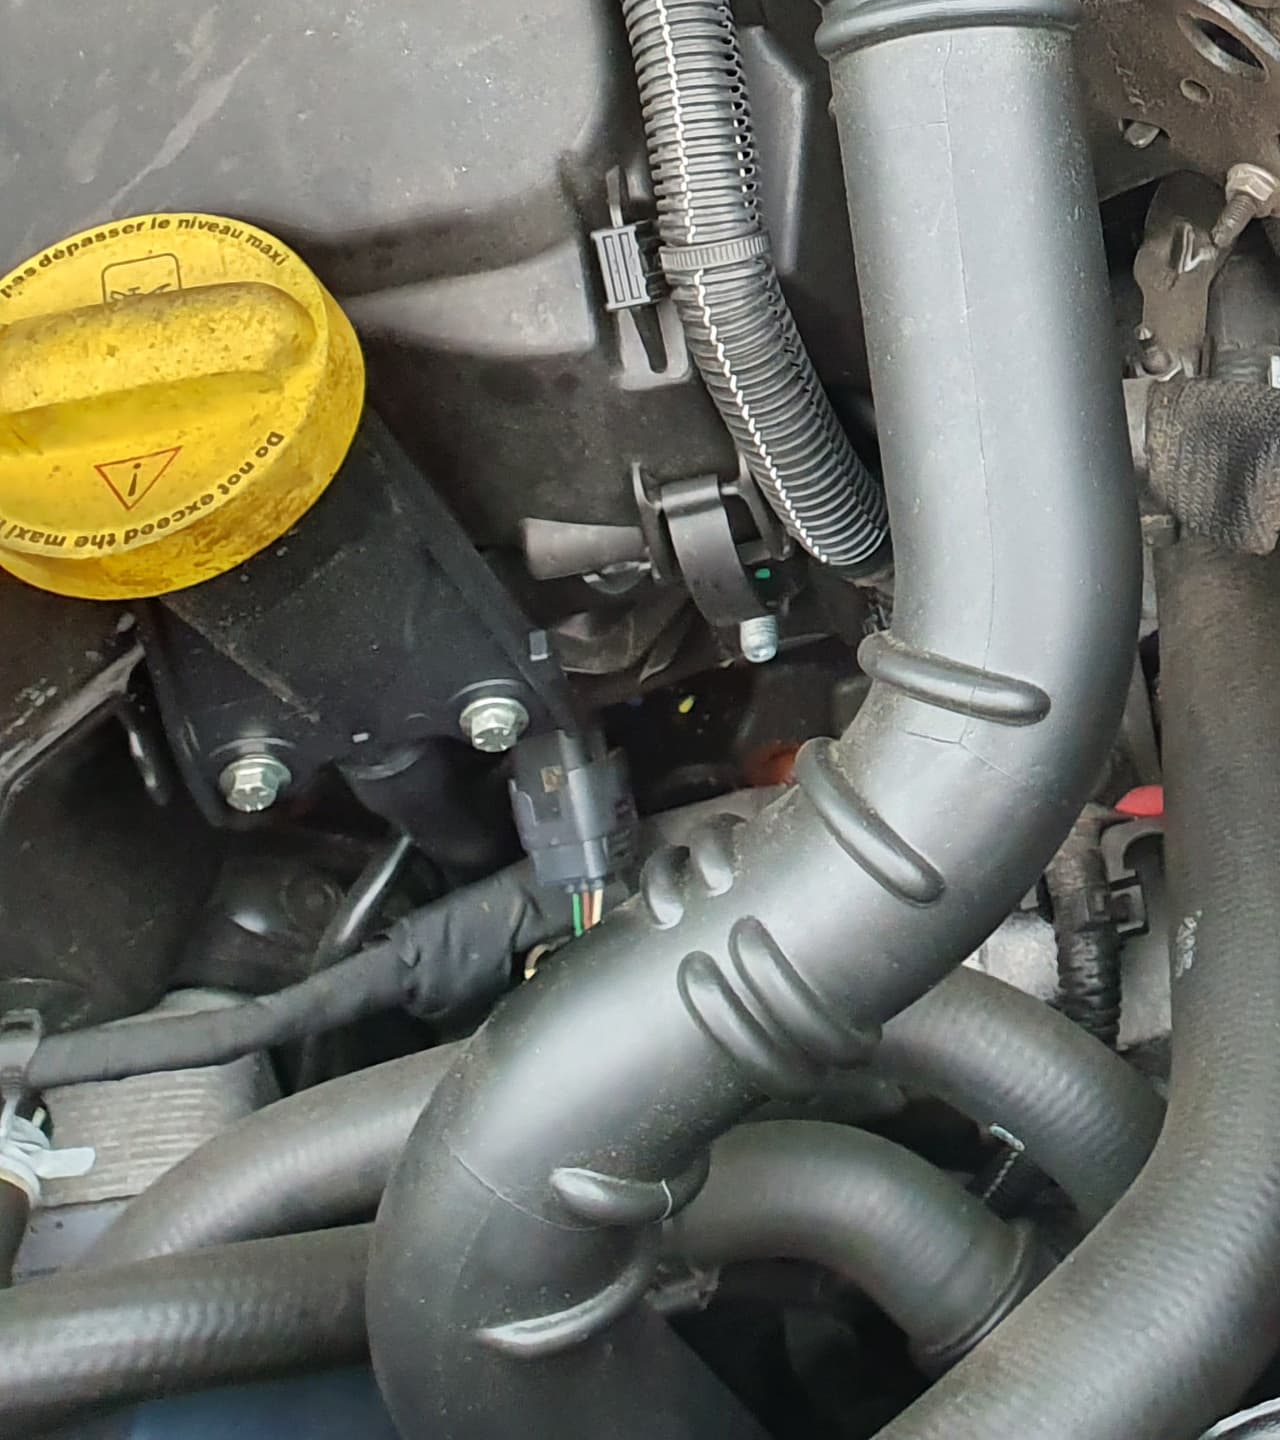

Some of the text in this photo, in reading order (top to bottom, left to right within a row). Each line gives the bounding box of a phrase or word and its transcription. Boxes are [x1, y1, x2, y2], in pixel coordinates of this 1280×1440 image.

[0, 216, 290, 299] pas dépasser le niveau maxi
[3, 431, 285, 550] Do not exceed the maxi
